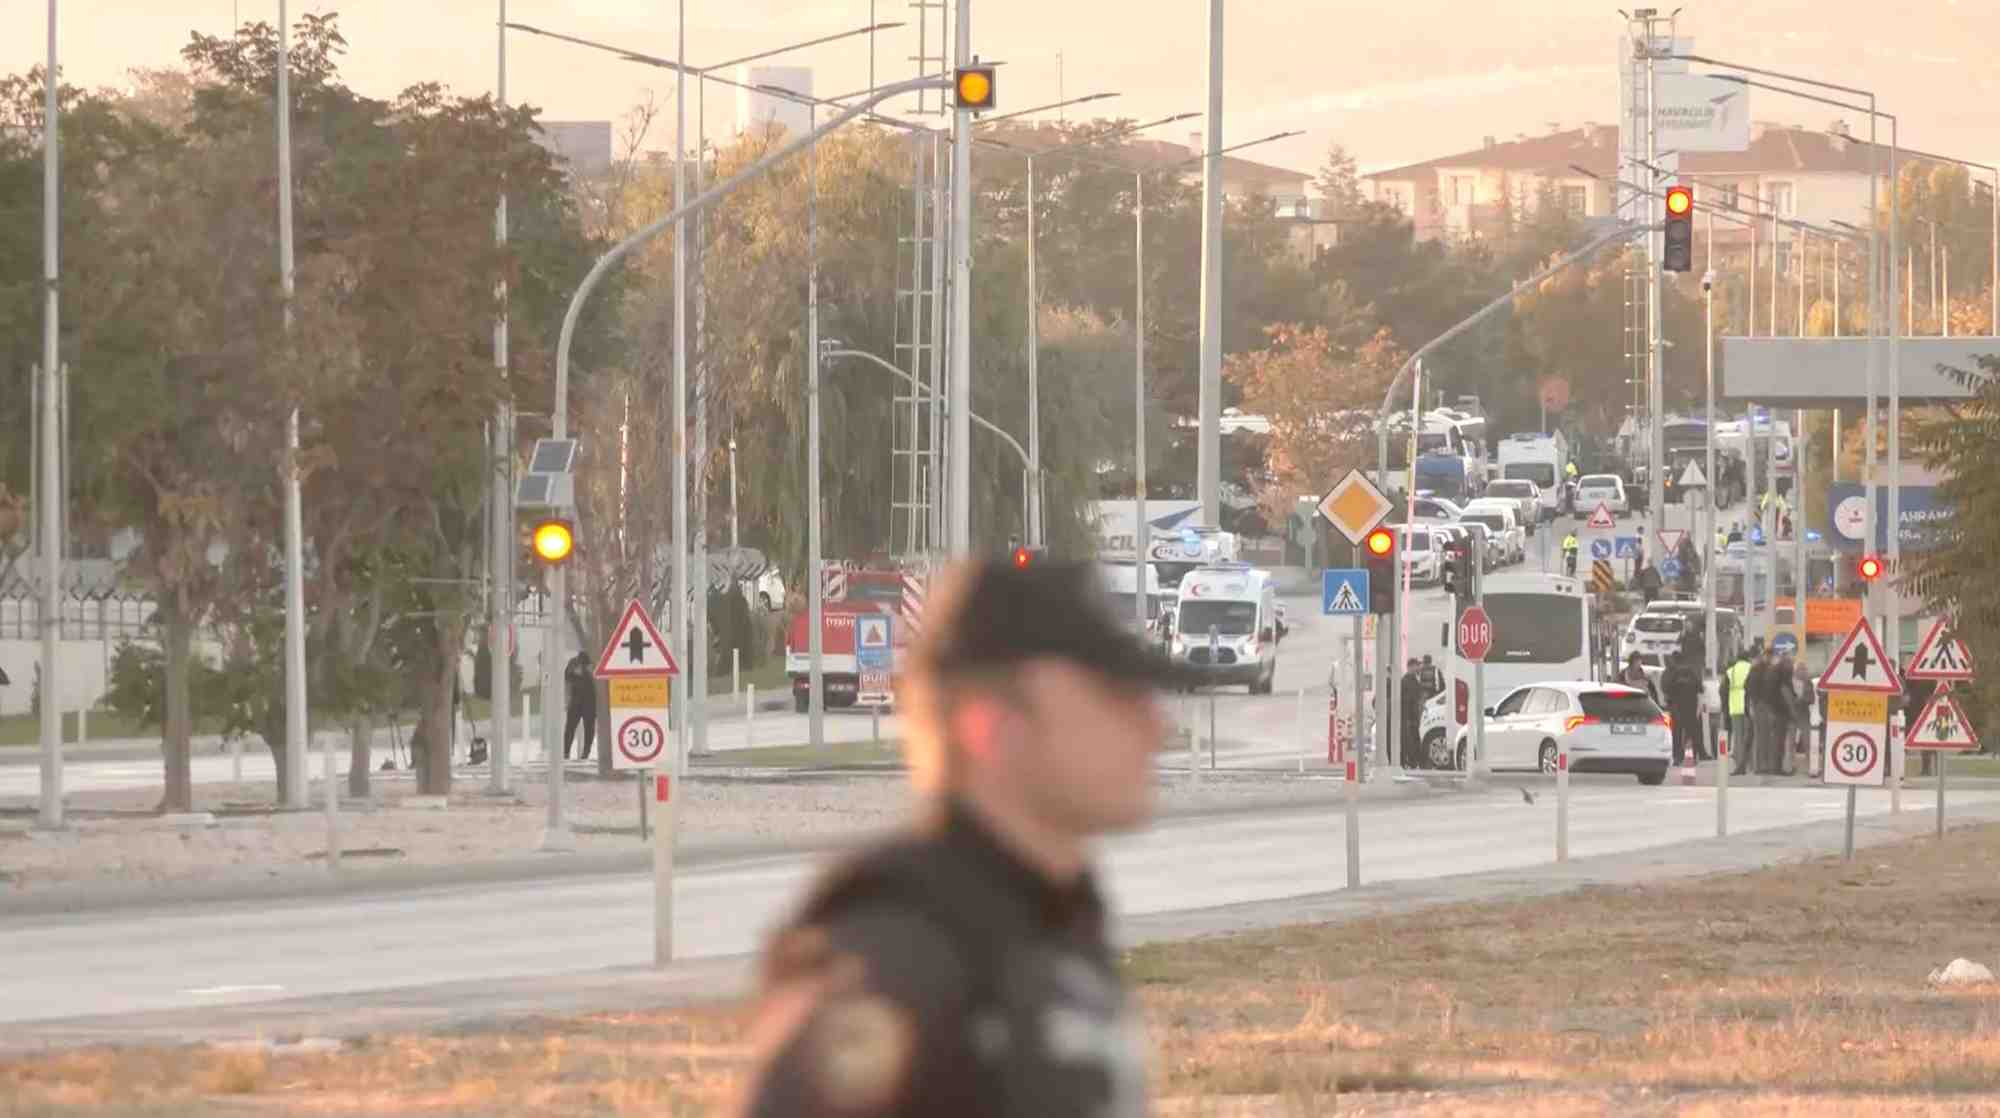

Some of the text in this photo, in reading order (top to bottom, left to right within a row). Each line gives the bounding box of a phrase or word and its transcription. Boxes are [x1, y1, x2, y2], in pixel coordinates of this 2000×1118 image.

[1461, 623, 1488, 645] DUR
[627, 728, 653, 748] 30
[1842, 743, 1868, 764] 30
